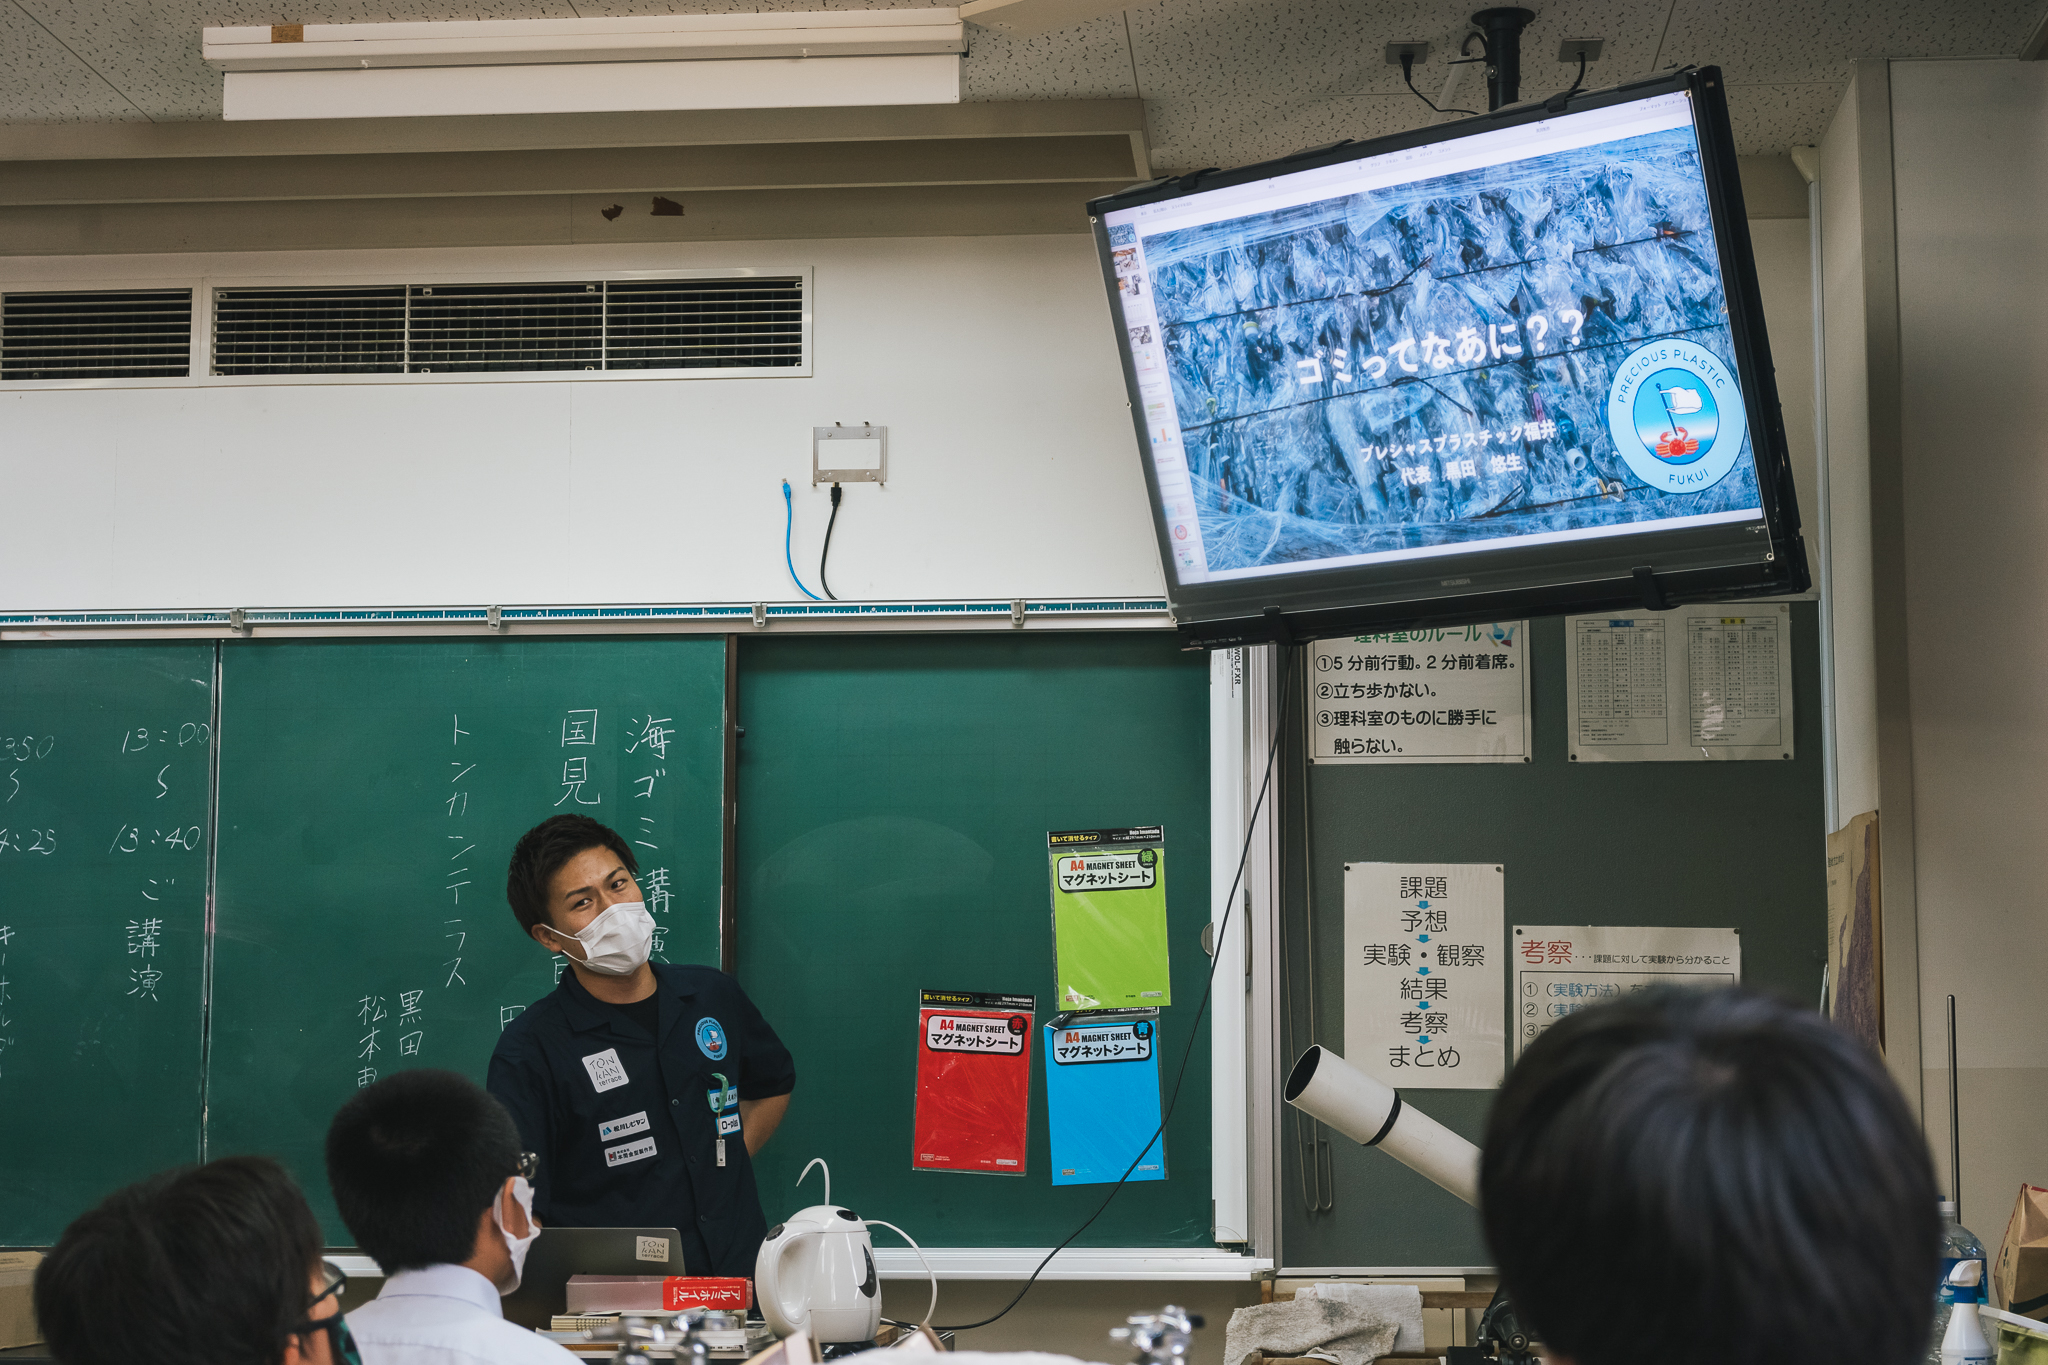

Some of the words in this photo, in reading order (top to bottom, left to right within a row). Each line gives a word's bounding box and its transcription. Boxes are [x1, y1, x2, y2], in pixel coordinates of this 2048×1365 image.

[1617, 349, 1668, 404] PRECIOUS
[1673, 349, 1726, 390] PLASTIC
[1360, 420, 1557, 463] プレシャスプラスチック福井
[1401, 465, 1433, 487] 代表
[1446, 459, 1478, 481] 黒田
[1490, 452, 1524, 474] 悠生
[1668, 468, 1710, 486] FUKUI
[1316, 682, 1436, 699] ②立ち歩かない。
[1316, 709, 1498, 727] ③理科室のものに勝手に
[122, 722, 210, 755] 13:00
[1333, 738, 1403, 754] 触らない。
[554, 708, 602, 806] 国見
[108, 823, 202, 854] 13:40
[443, 713, 477, 988] トンカンテラス
[1141, 850, 1154, 863] 緑
[1070, 860, 1085, 872] A4
[1086, 862, 1113, 871] MAGNET
[1115, 860, 1136, 869] SHEET
[1062, 870, 1151, 887] マグネットシート
[1400, 876, 1448, 900] 課題
[1400, 910, 1448, 933] 予想
[124, 877, 175, 1002] ご講演
[1363, 944, 1486, 968] 実験・観察
[1520, 939, 1573, 965] 考察
[1400, 977, 1448, 1001] 結果
[399, 989, 425, 1058] 黒田
[940, 1019, 955, 1031] A4
[955, 1023, 983, 1033] MAGNET
[984, 1024, 1006, 1034] SHEET
[1012, 1018, 1024, 1030] 赤
[1136, 1022, 1149, 1035] 青
[1400, 1011, 1448, 1035] 考察
[931, 1033, 1019, 1050] マグネットシート
[1065, 1031, 1080, 1044] A4
[1081, 1034, 1109, 1043] MAGNET
[1110, 1032, 1132, 1042] SHEET
[1057, 1042, 1147, 1059] マグネットシート
[1388, 1045, 1461, 1069] まとめ
[589, 1056, 616, 1070] TON
[598, 1074, 623, 1087] terrace
[641, 1240, 665, 1249] TON
[678, 1289, 741, 1302] アルミホイル
